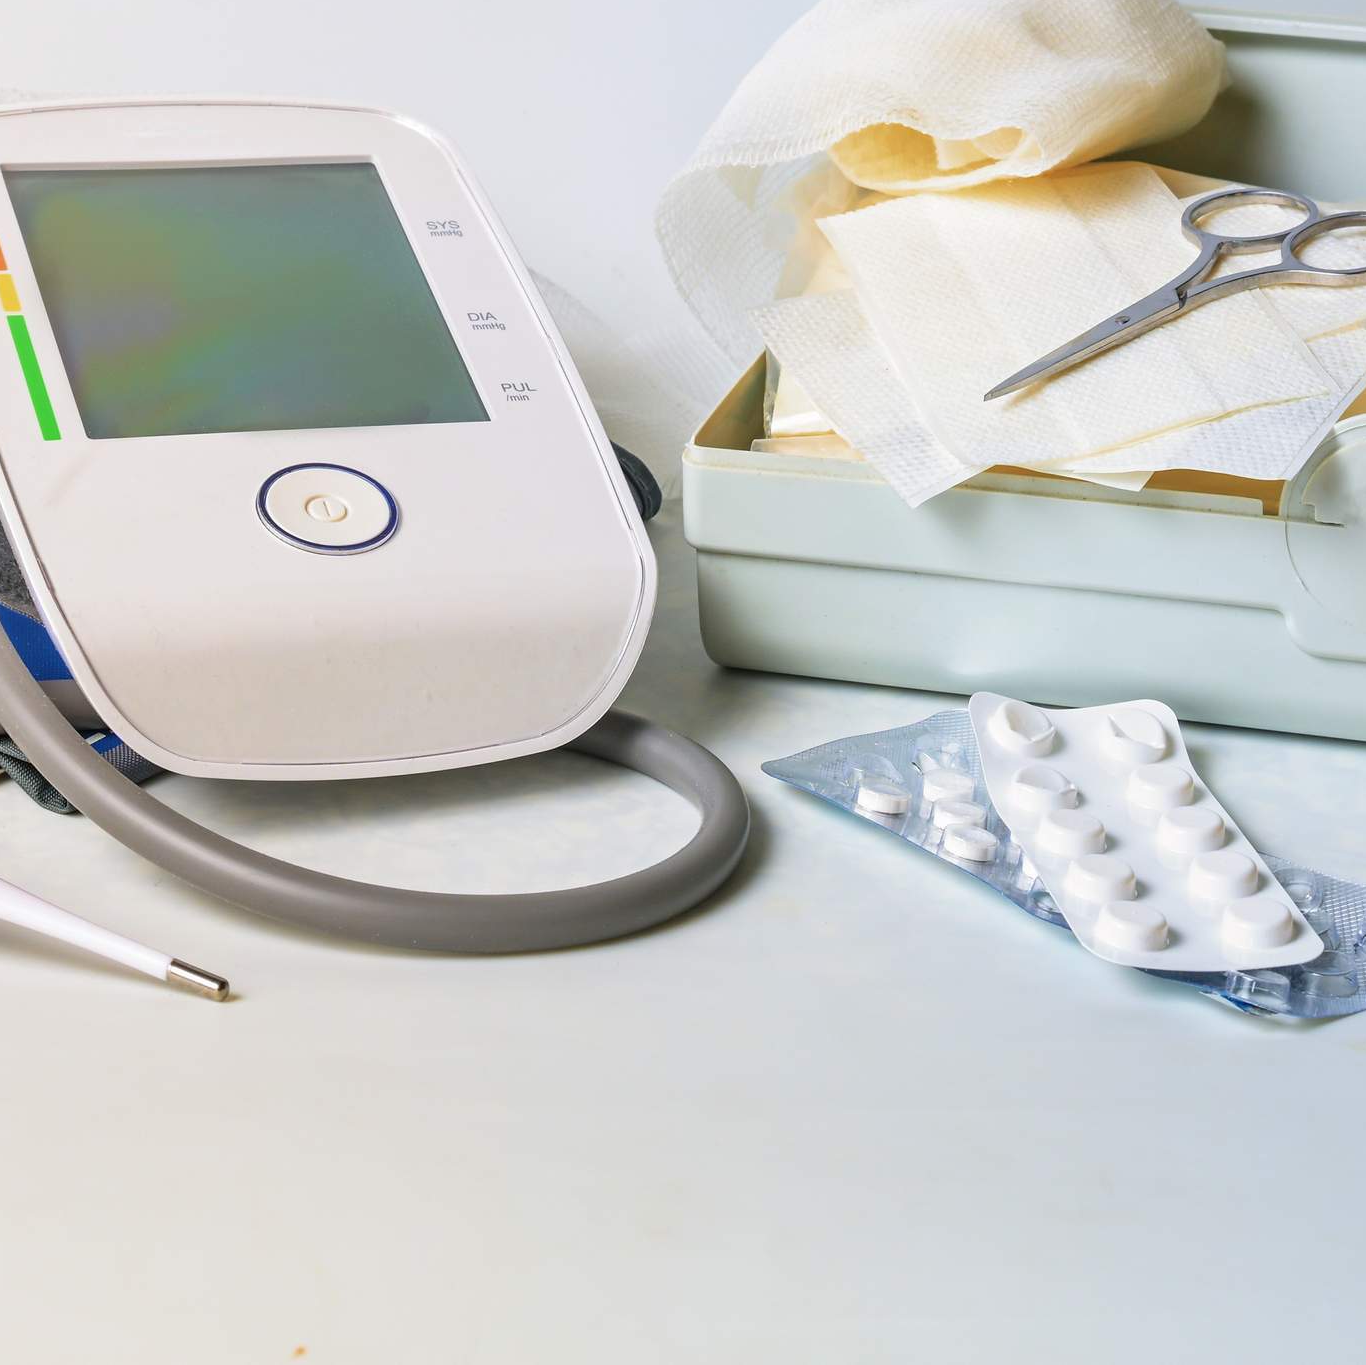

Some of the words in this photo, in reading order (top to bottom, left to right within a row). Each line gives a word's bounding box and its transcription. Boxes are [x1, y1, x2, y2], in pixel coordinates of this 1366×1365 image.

[426, 220, 460, 230] SYS
[430, 229, 463, 237] mmHg
[467, 312, 498, 321] DIA
[472, 322, 506, 331] mmHg
[501, 382, 538, 392] PUL
[506, 394, 530, 402] /min
